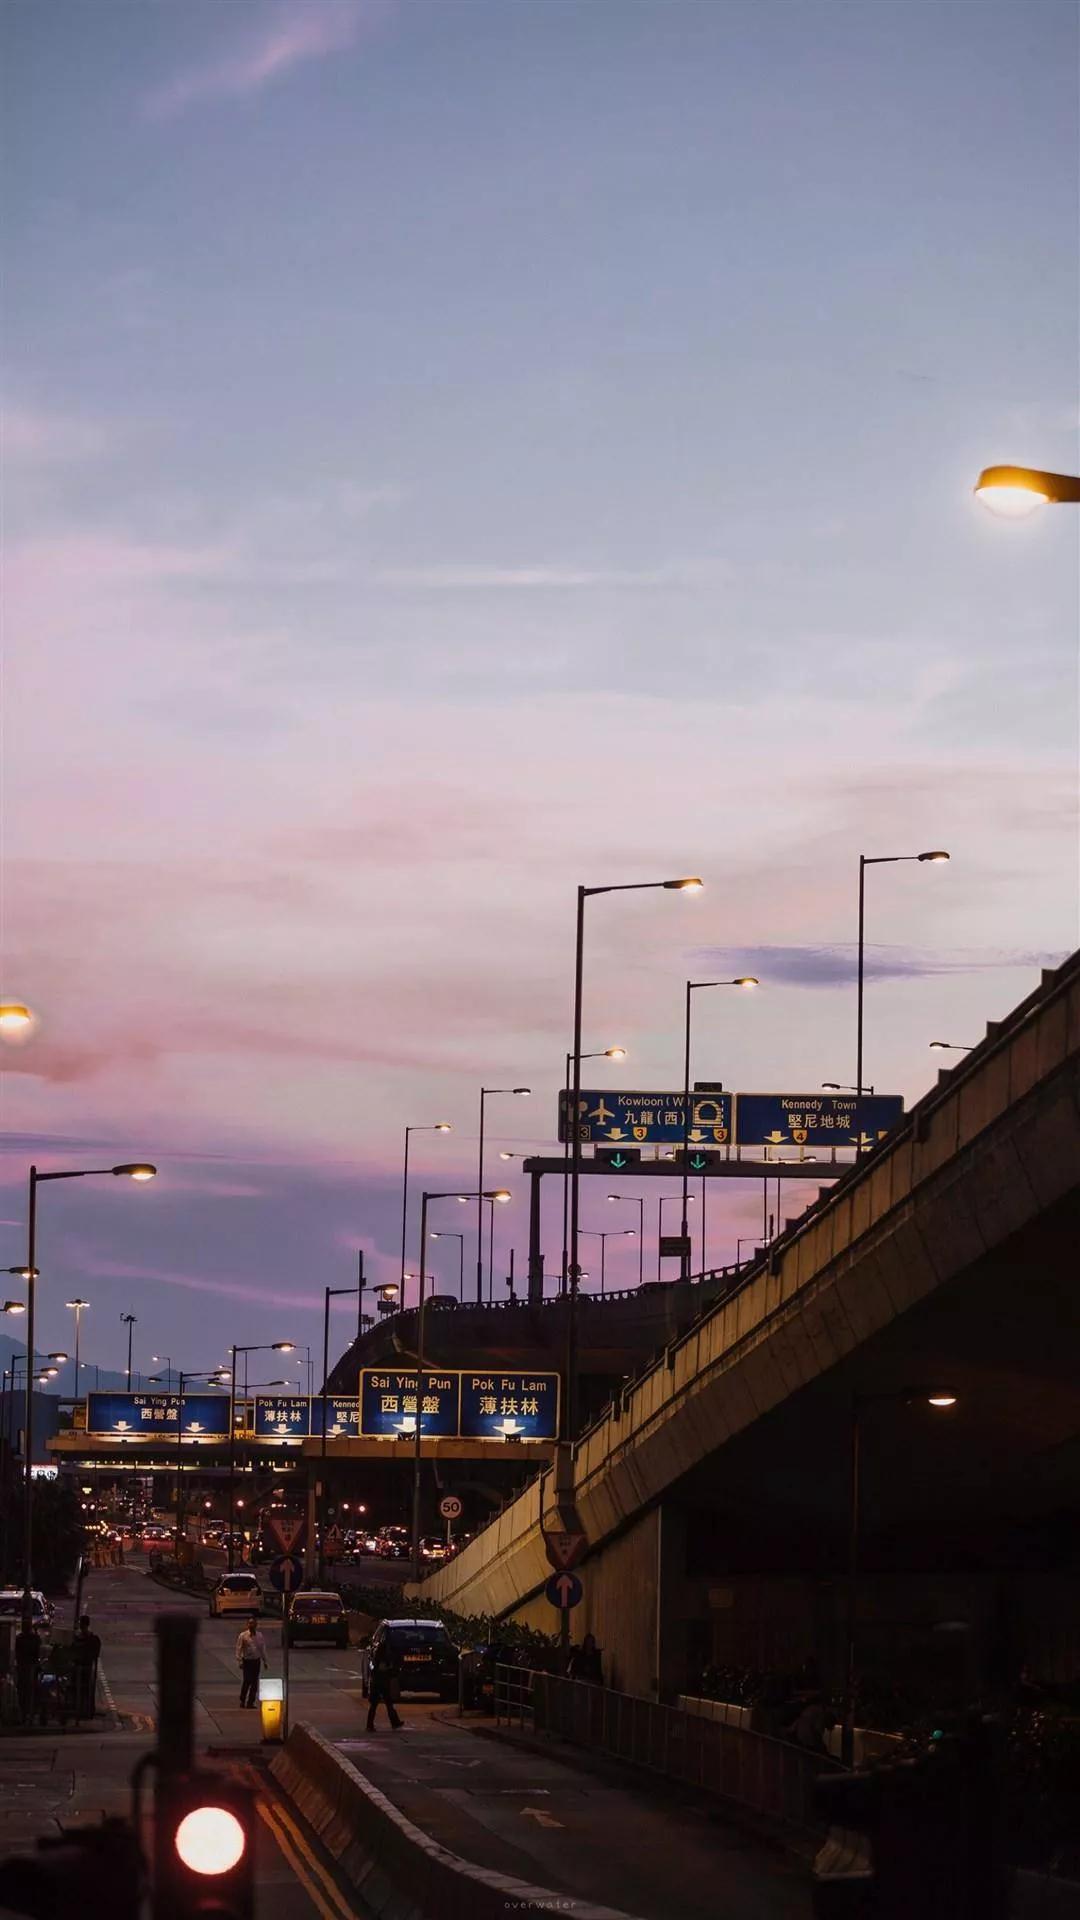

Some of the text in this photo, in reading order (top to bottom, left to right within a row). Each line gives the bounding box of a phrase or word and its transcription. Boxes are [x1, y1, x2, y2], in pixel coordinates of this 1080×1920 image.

[618, 1095, 664, 1107] Kowloon
[781, 1099, 857, 1112] Kennedy Town
[788, 1113, 851, 1129] 堅尼地城
[636, 1128, 644, 1139] 3
[717, 1129, 725, 1140] 3
[796, 1131, 804, 1141] 4
[371, 1375, 390, 1388] Sai
[428, 1377, 451, 1389] Pun
[472, 1378, 547, 1392] Pok Fu Lam
[134, 1396, 186, 1407] Sai Ying Pun
[258, 1399, 307, 1407] Pok Fu Lam
[381, 1395, 440, 1414] 西營盤
[479, 1396, 539, 1416] 薄扶林
[141, 1408, 177, 1420] 西營盤
[264, 1410, 302, 1422] 薄扶林
[442, 1502, 460, 1513] 50
